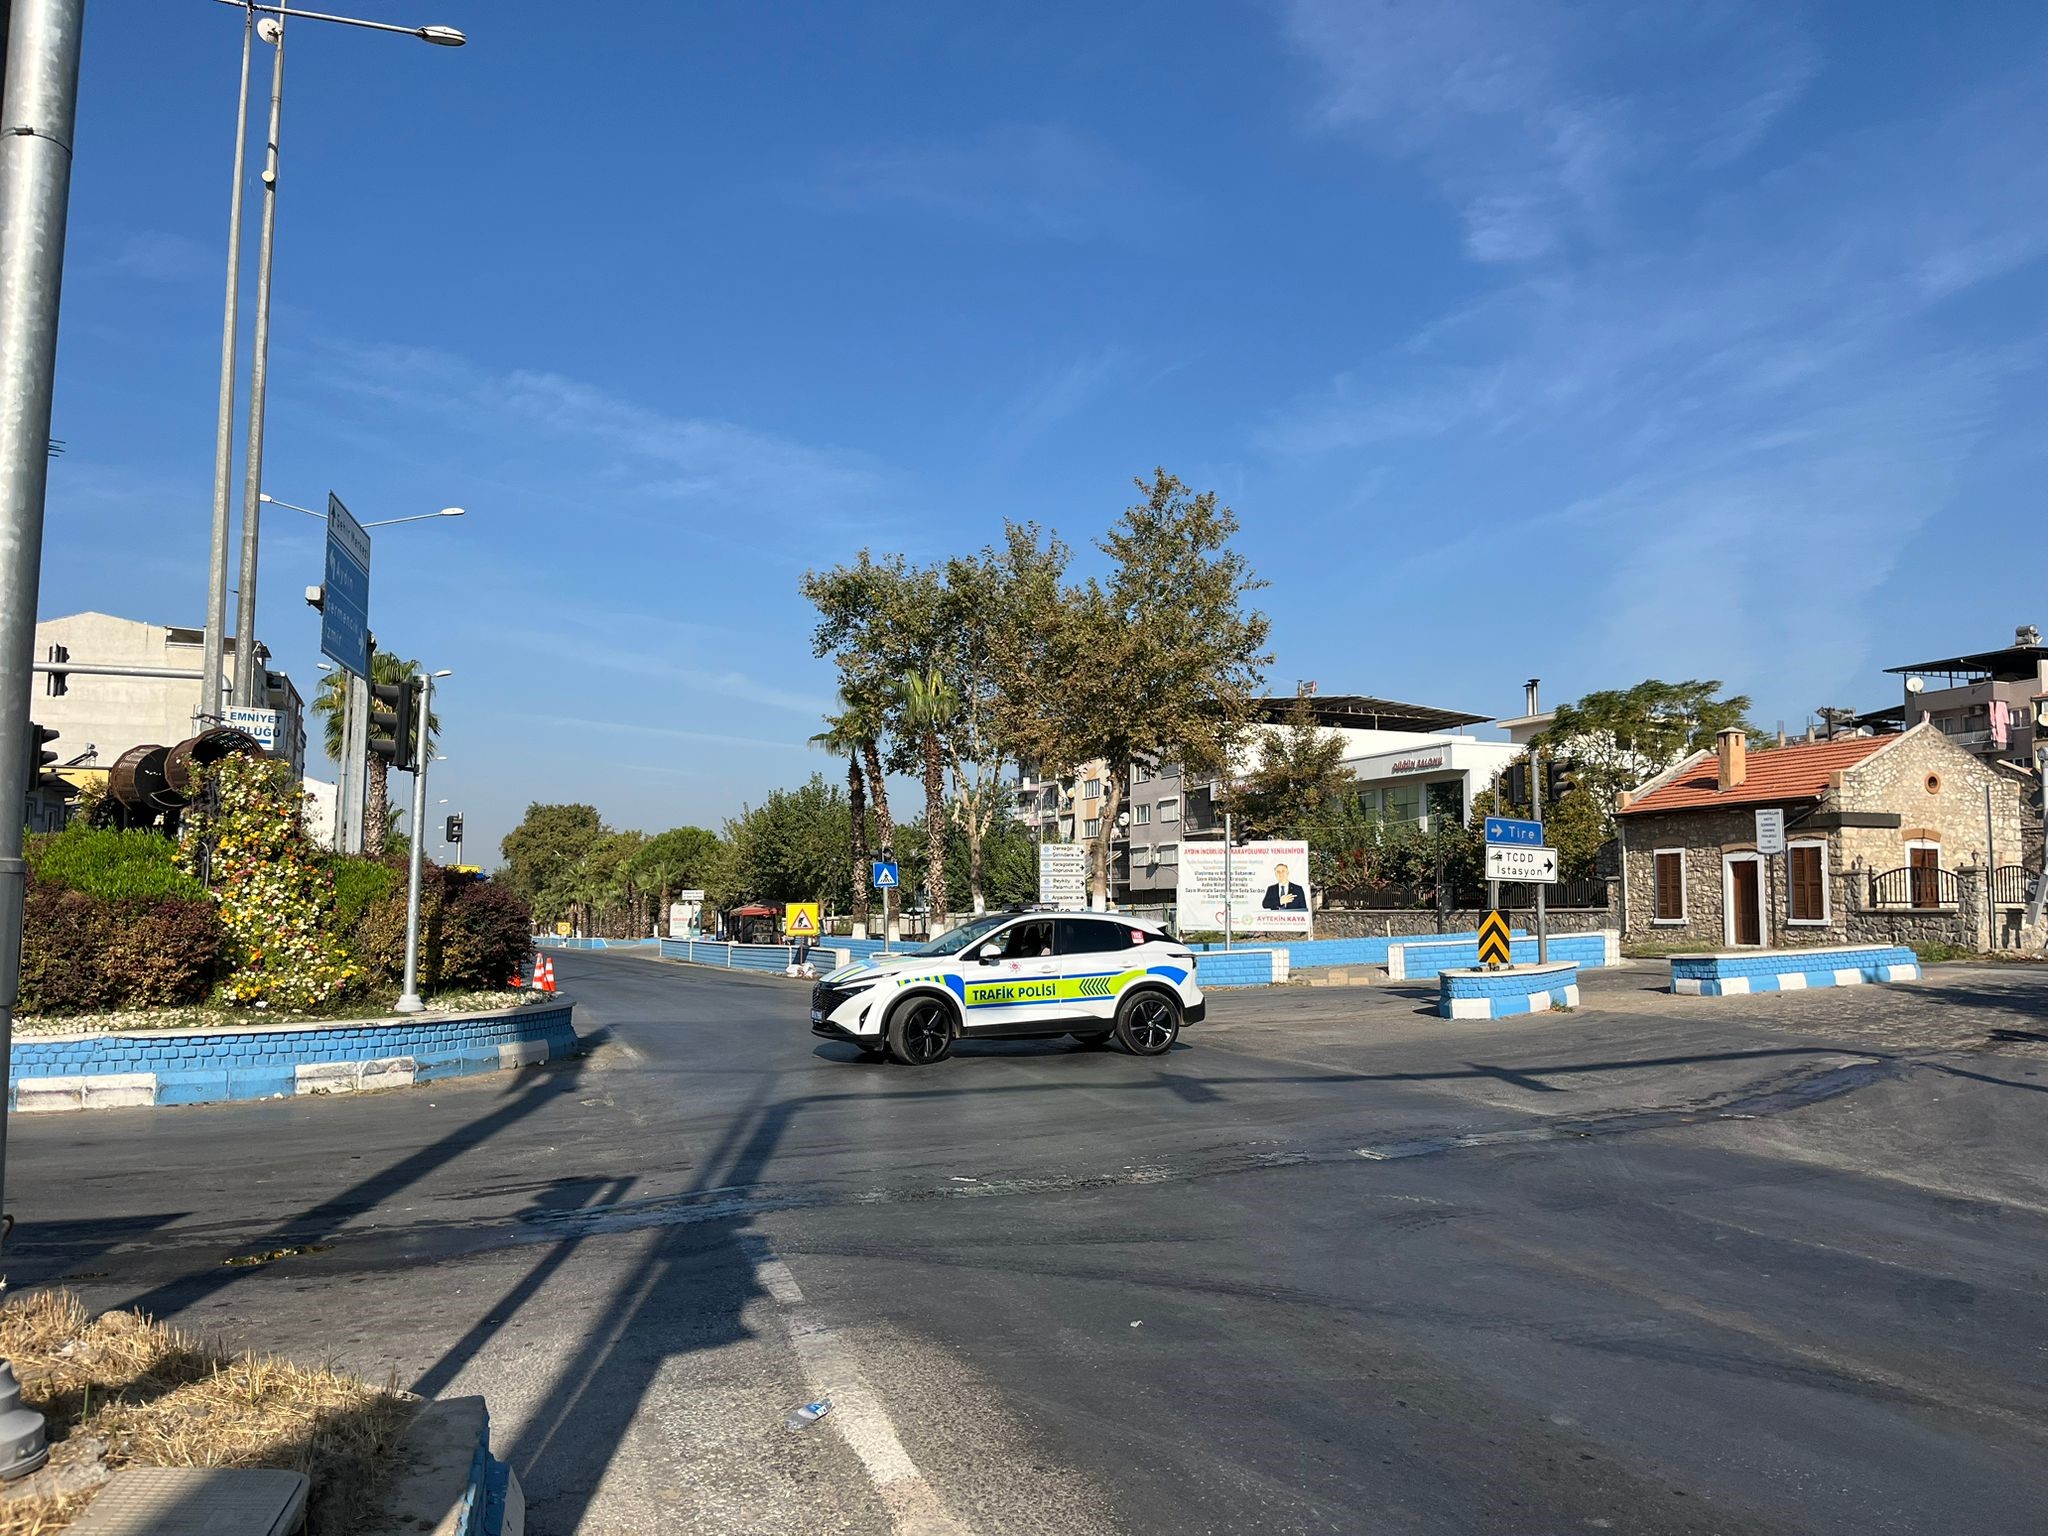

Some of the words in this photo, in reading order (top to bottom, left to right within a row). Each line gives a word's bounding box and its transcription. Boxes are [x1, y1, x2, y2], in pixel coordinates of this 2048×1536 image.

[336, 561, 353, 591] Aydın
[230, 711, 282, 724] EMNİYET
[1508, 825, 1535, 840] Tire
[1200, 847, 1226, 855] İNCİRLİOV
[1506, 852, 1534, 863] TCDD
[972, 985, 1014, 1001] TRAFİK
[1018, 983, 1056, 998] POLİSİ
